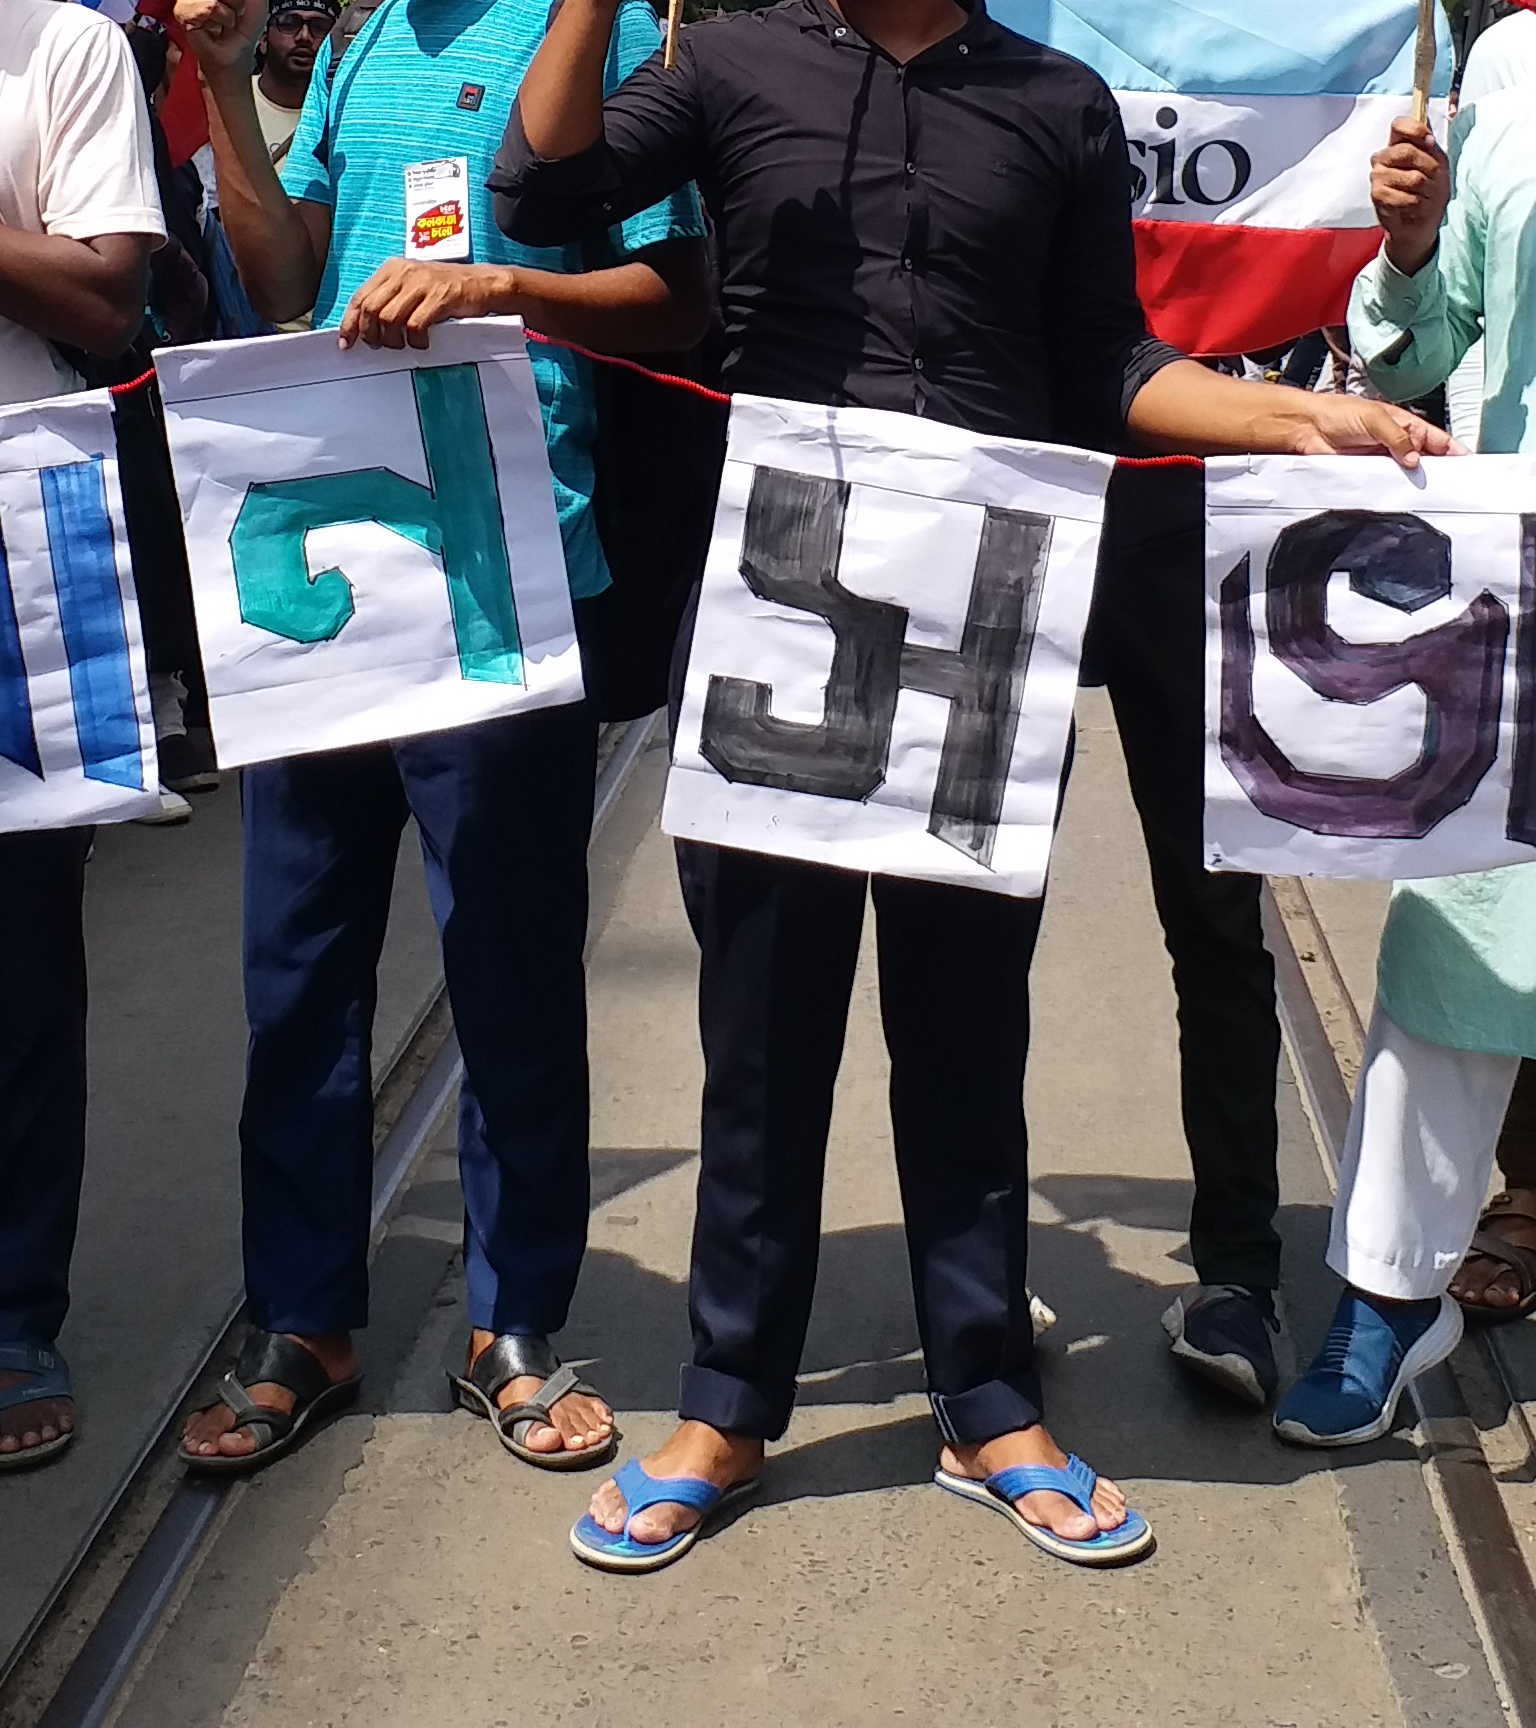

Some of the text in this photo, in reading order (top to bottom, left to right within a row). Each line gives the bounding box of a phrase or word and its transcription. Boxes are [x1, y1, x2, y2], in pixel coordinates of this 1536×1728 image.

[417, 214, 457, 229] কলকাতা
[431, 226, 453, 239] চলো
[699, 464, 1055, 872] স
